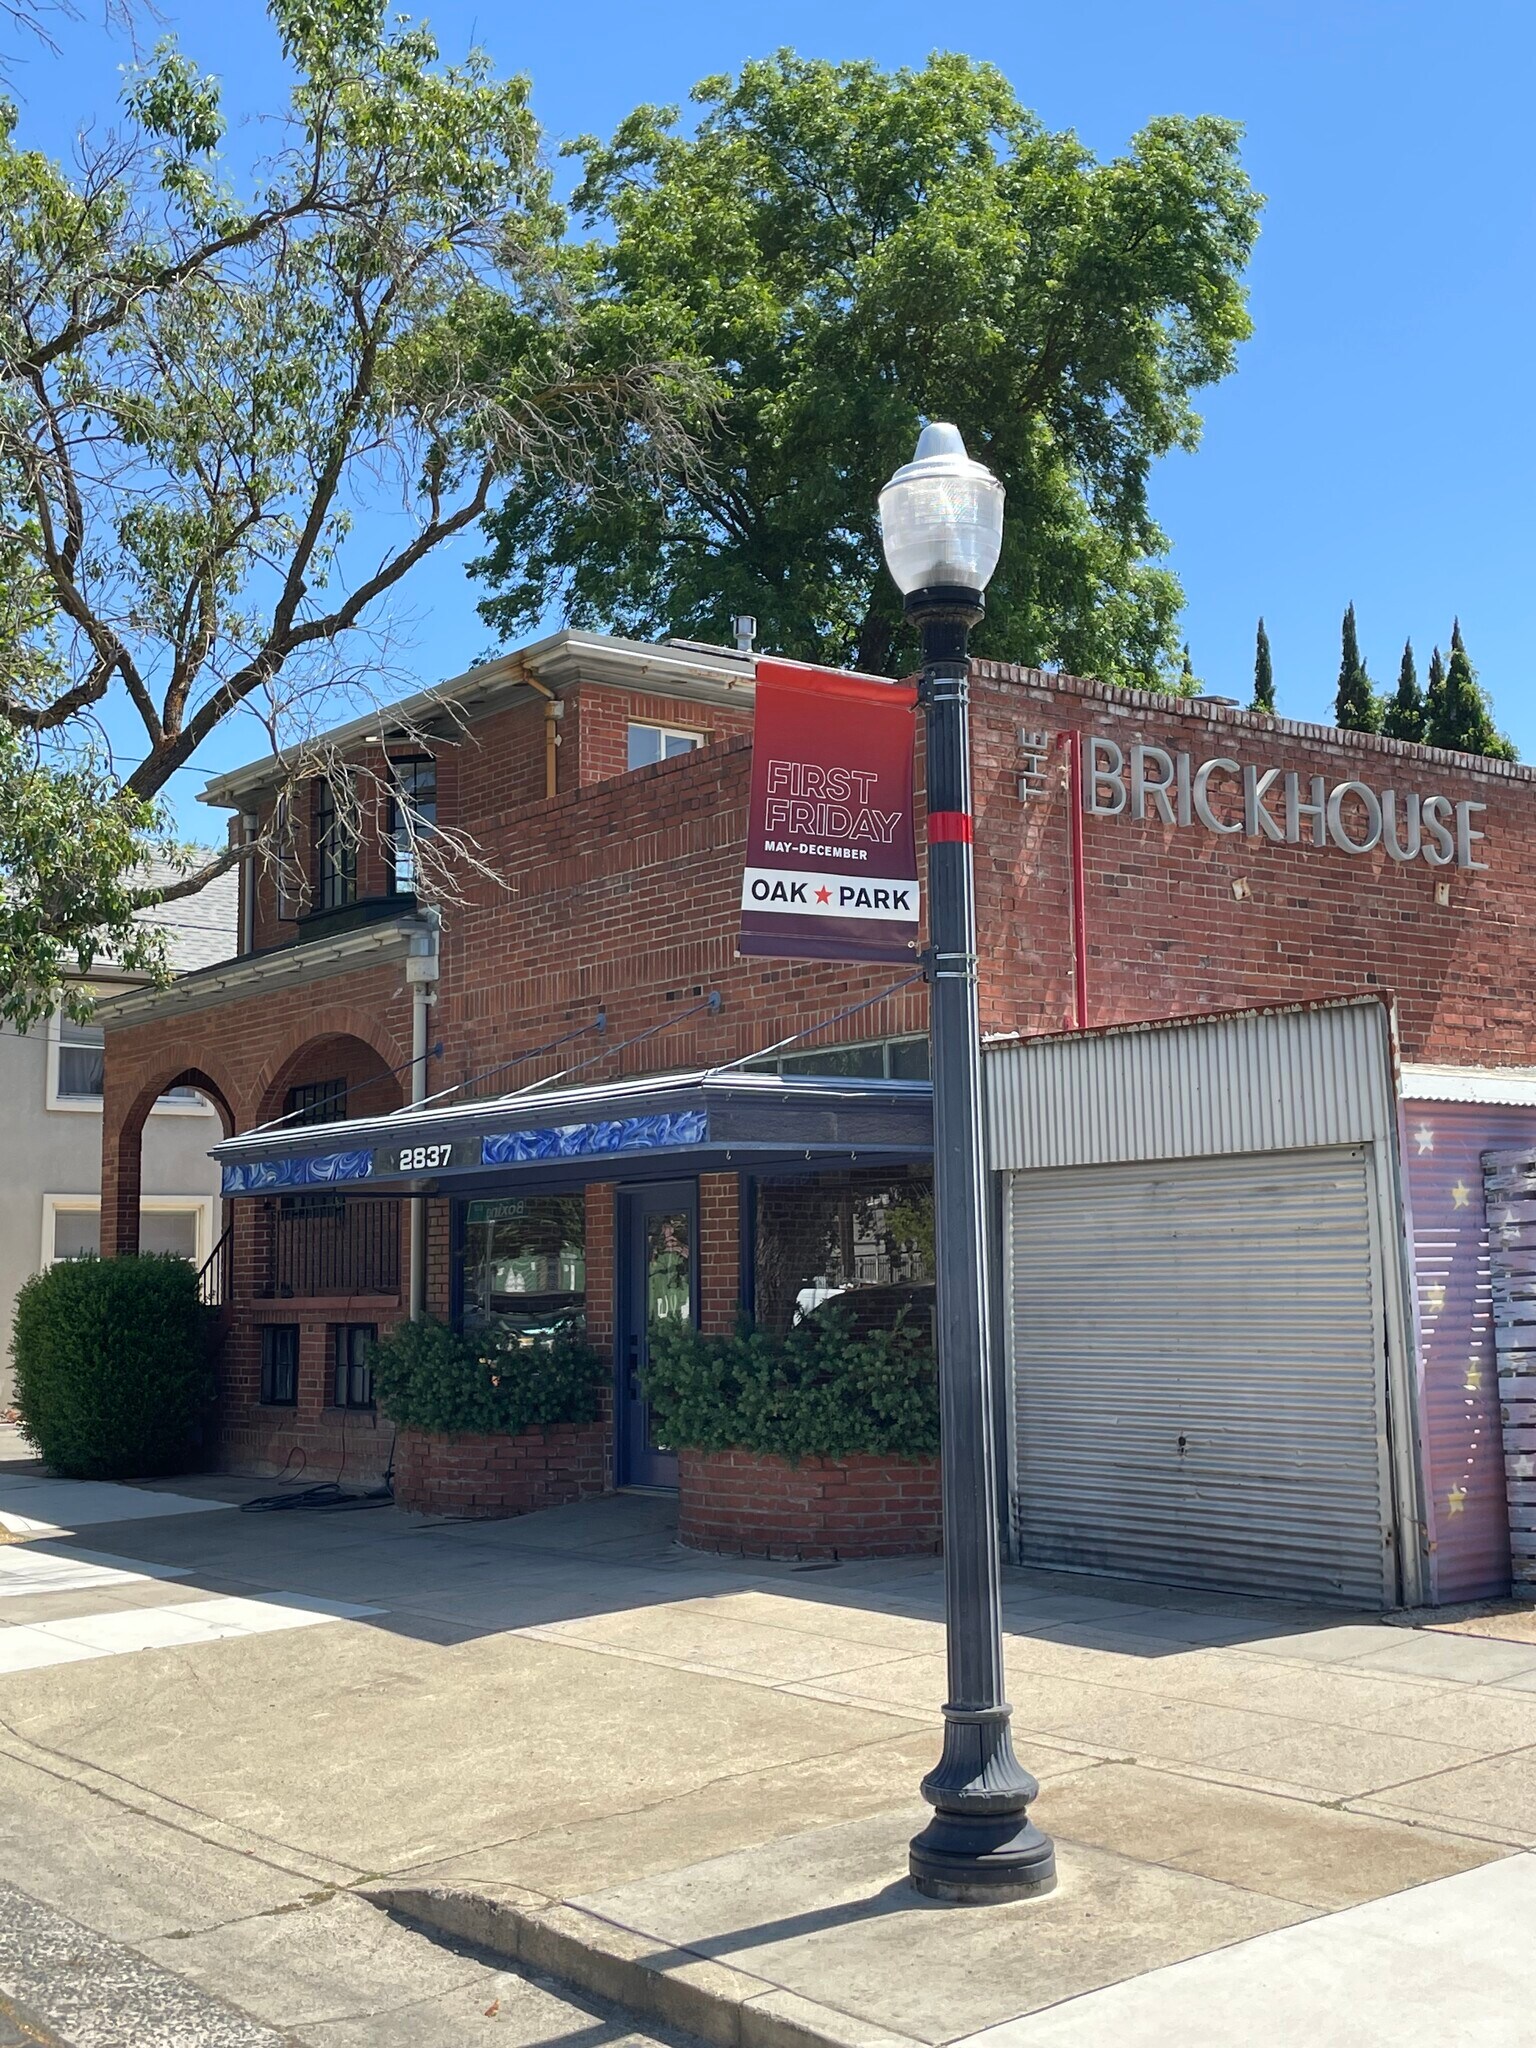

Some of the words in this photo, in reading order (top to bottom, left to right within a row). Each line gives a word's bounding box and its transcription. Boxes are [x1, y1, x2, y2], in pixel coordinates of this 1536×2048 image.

[767, 759, 878, 804] FIRST
[1018, 728, 1048, 802] THE
[1083, 736, 1489, 871] BRICKHOUSE
[764, 797, 903, 844] FRIDAY
[751, 878, 809, 904] OAK
[839, 885, 911, 911] PARK
[399, 1144, 452, 1171] 2837
